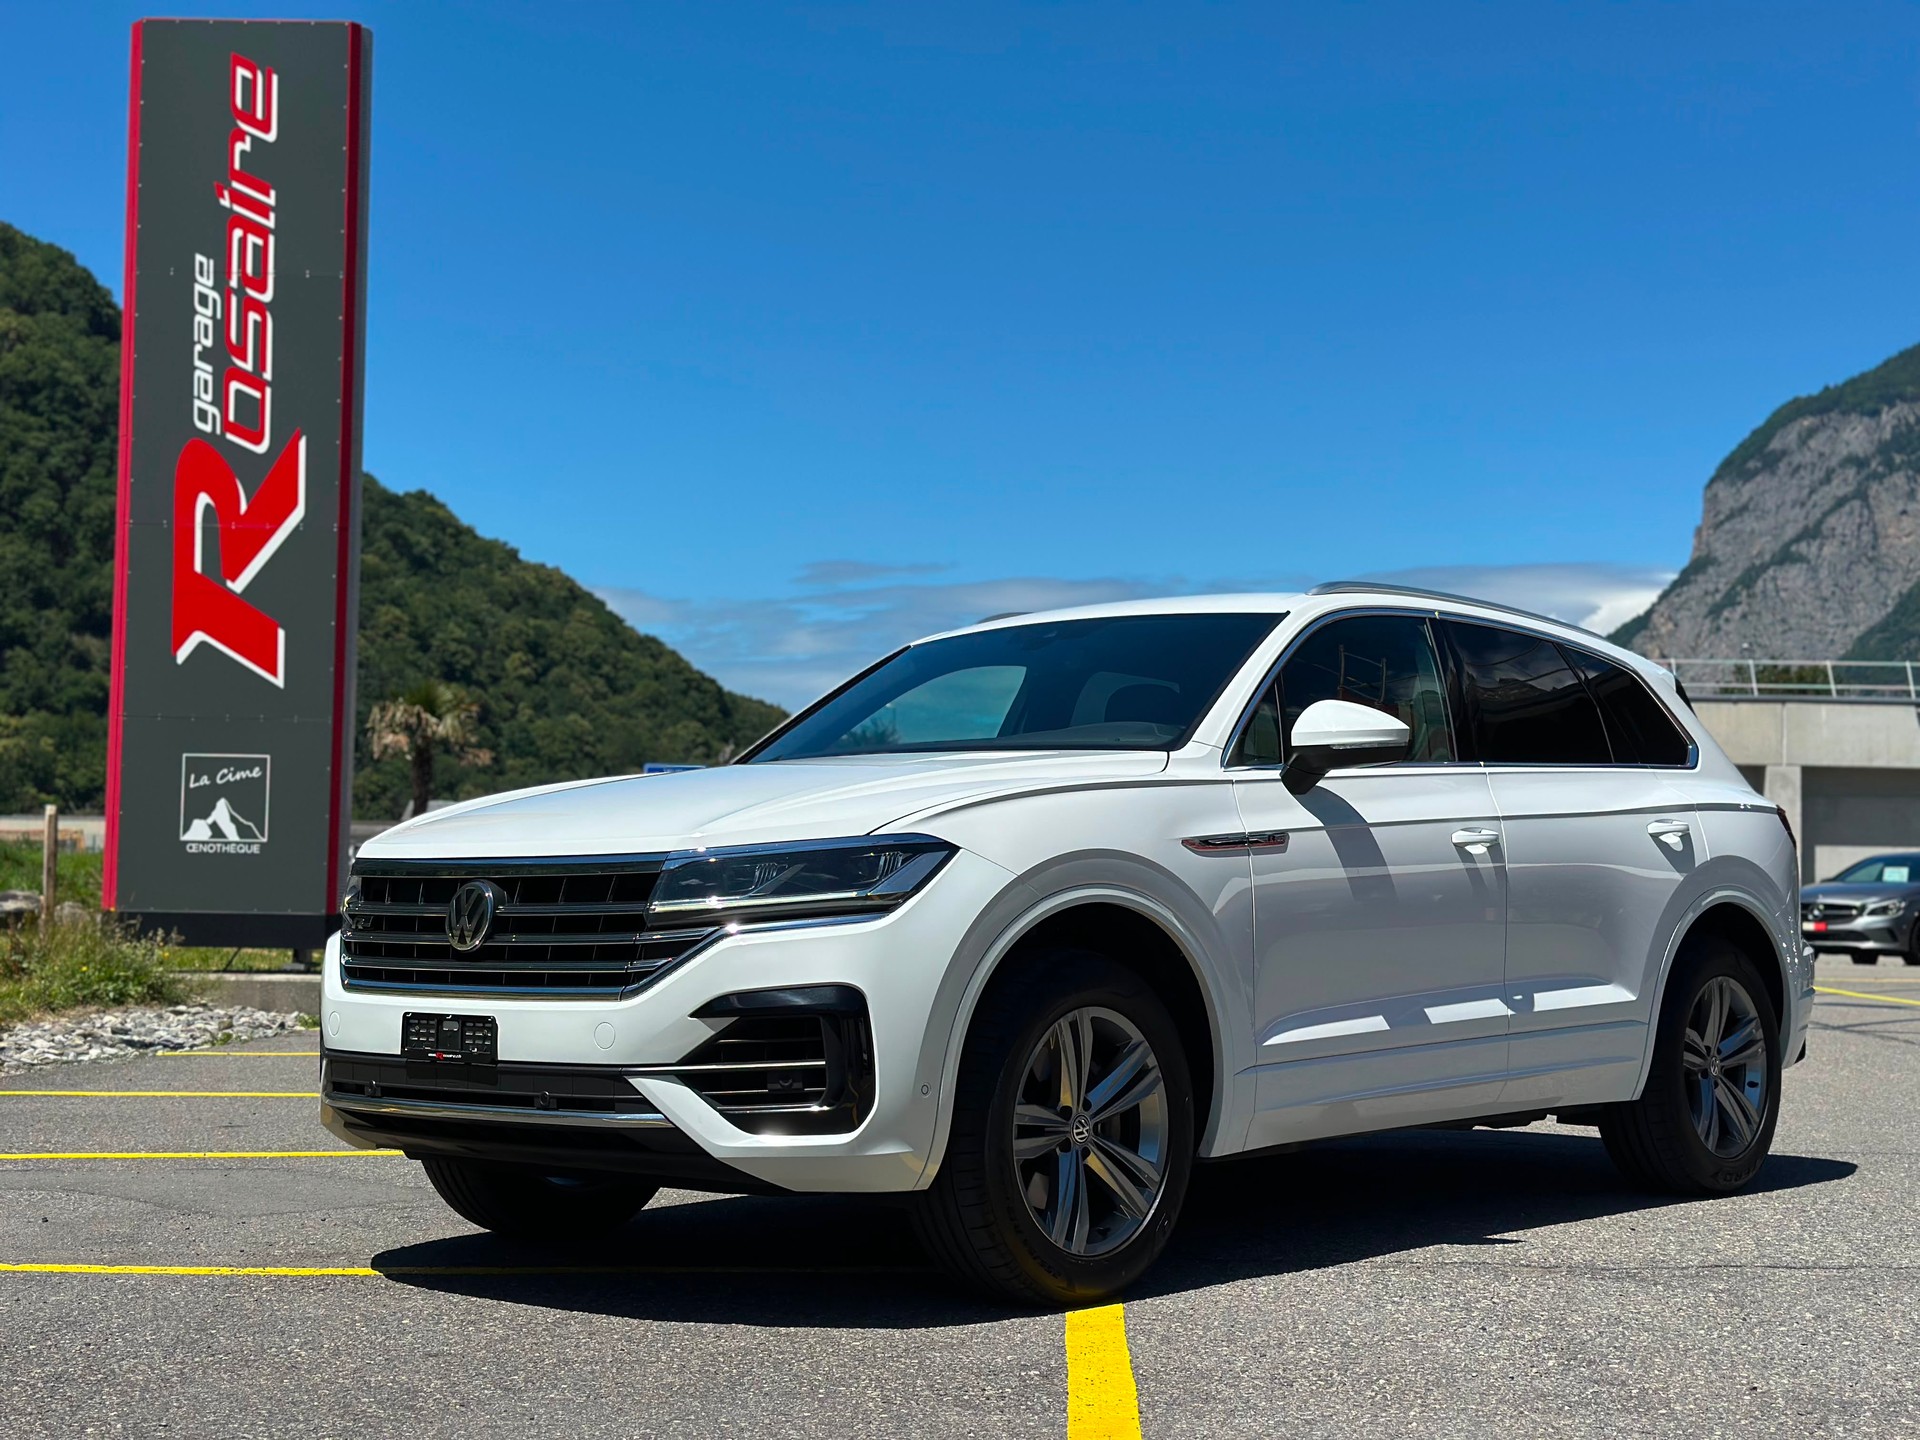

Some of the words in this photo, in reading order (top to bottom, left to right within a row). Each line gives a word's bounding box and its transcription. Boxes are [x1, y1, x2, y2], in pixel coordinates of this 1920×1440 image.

[171, 52, 305, 688] Rosaire
[193, 253, 221, 436] garage
[189, 773, 211, 788] La
[216, 766, 262, 785] Cime
